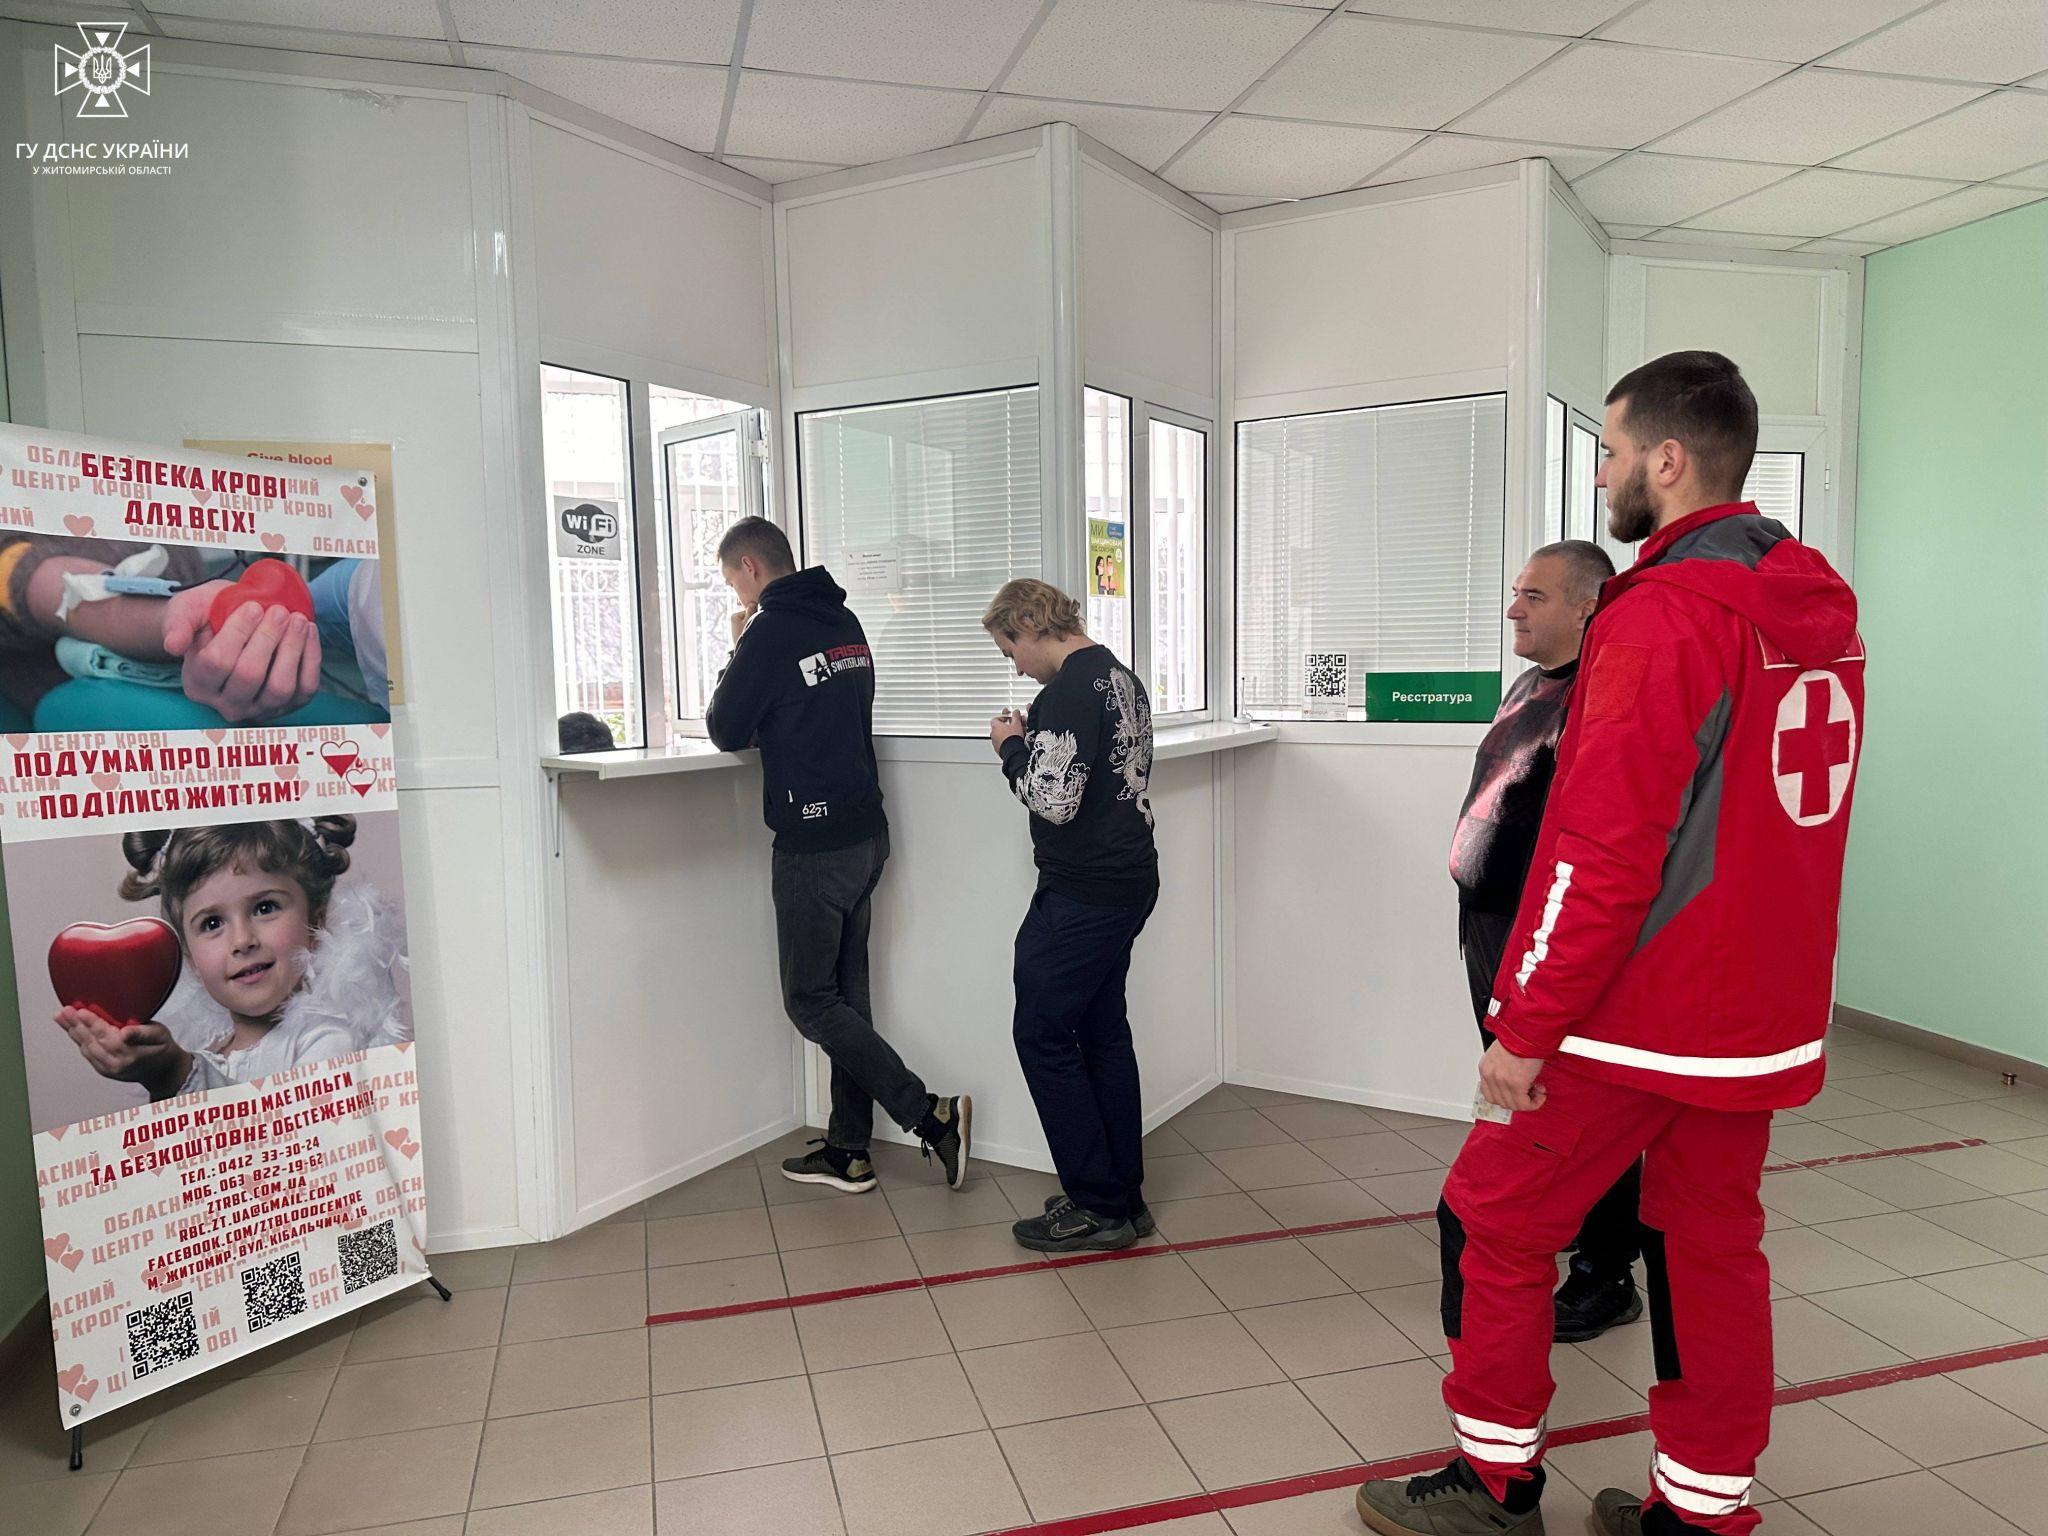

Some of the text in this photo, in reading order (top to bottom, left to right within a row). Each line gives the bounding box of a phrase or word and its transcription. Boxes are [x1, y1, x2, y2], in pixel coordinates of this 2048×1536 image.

[81, 452, 287, 499] БЕЗПЕКА КРОВІ
[288, 454, 333, 465] blood
[12, 469, 152, 500] ЦЕНТР КРОВІ
[125, 500, 256, 534] ДЛЯ ВСІХ!
[219, 493, 332, 519] ЦЕНТР КРОВІ
[313, 536, 376, 554] ОБЛАСН
[577, 545, 606, 555] ZONE
[1392, 691, 1472, 706] Реєстратура
[37, 733, 105, 752] ЦЕНТР
[233, 726, 346, 745] ЦЕНТР КРОВІ
[14, 744, 154, 777] ПОДУМАЙ
[160, 747, 210, 770] ПРО
[217, 743, 300, 768] ІНШИХ
[39, 788, 182, 819] ПОДІЛИСЯ
[186, 781, 300, 810] ЖИТТЯМ!
[123, 1113, 188, 1149] ДОНОР
[194, 1100, 257, 1127] КРОВІ
[294, 1071, 353, 1101] ПІЛЬГИ
[91, 1090, 375, 1186] ТА БЕЗКОШТОВНЕ ОБСТЕЖЕННЯ!
[180, 1136, 319, 1186] ТЕЛ.: 0412 33-30-24
[183, 1153, 323, 1204] МОБ. 063 822-19-62
[207, 1176, 306, 1214] ZTRBC.COM.UA
[148, 1190, 363, 1271] FACEBOOK.COM/ZTBLOODCENTRE
[179, 1184, 335, 1242] RBC.ZT.UA@GMAIL.COM
[92, 1229, 154, 1264] ЦЕНТР
[147, 1276, 163, 1290] М.
[239, 1239, 268, 1257] ВУЛ.
[356, 1205, 367, 1218] 16
